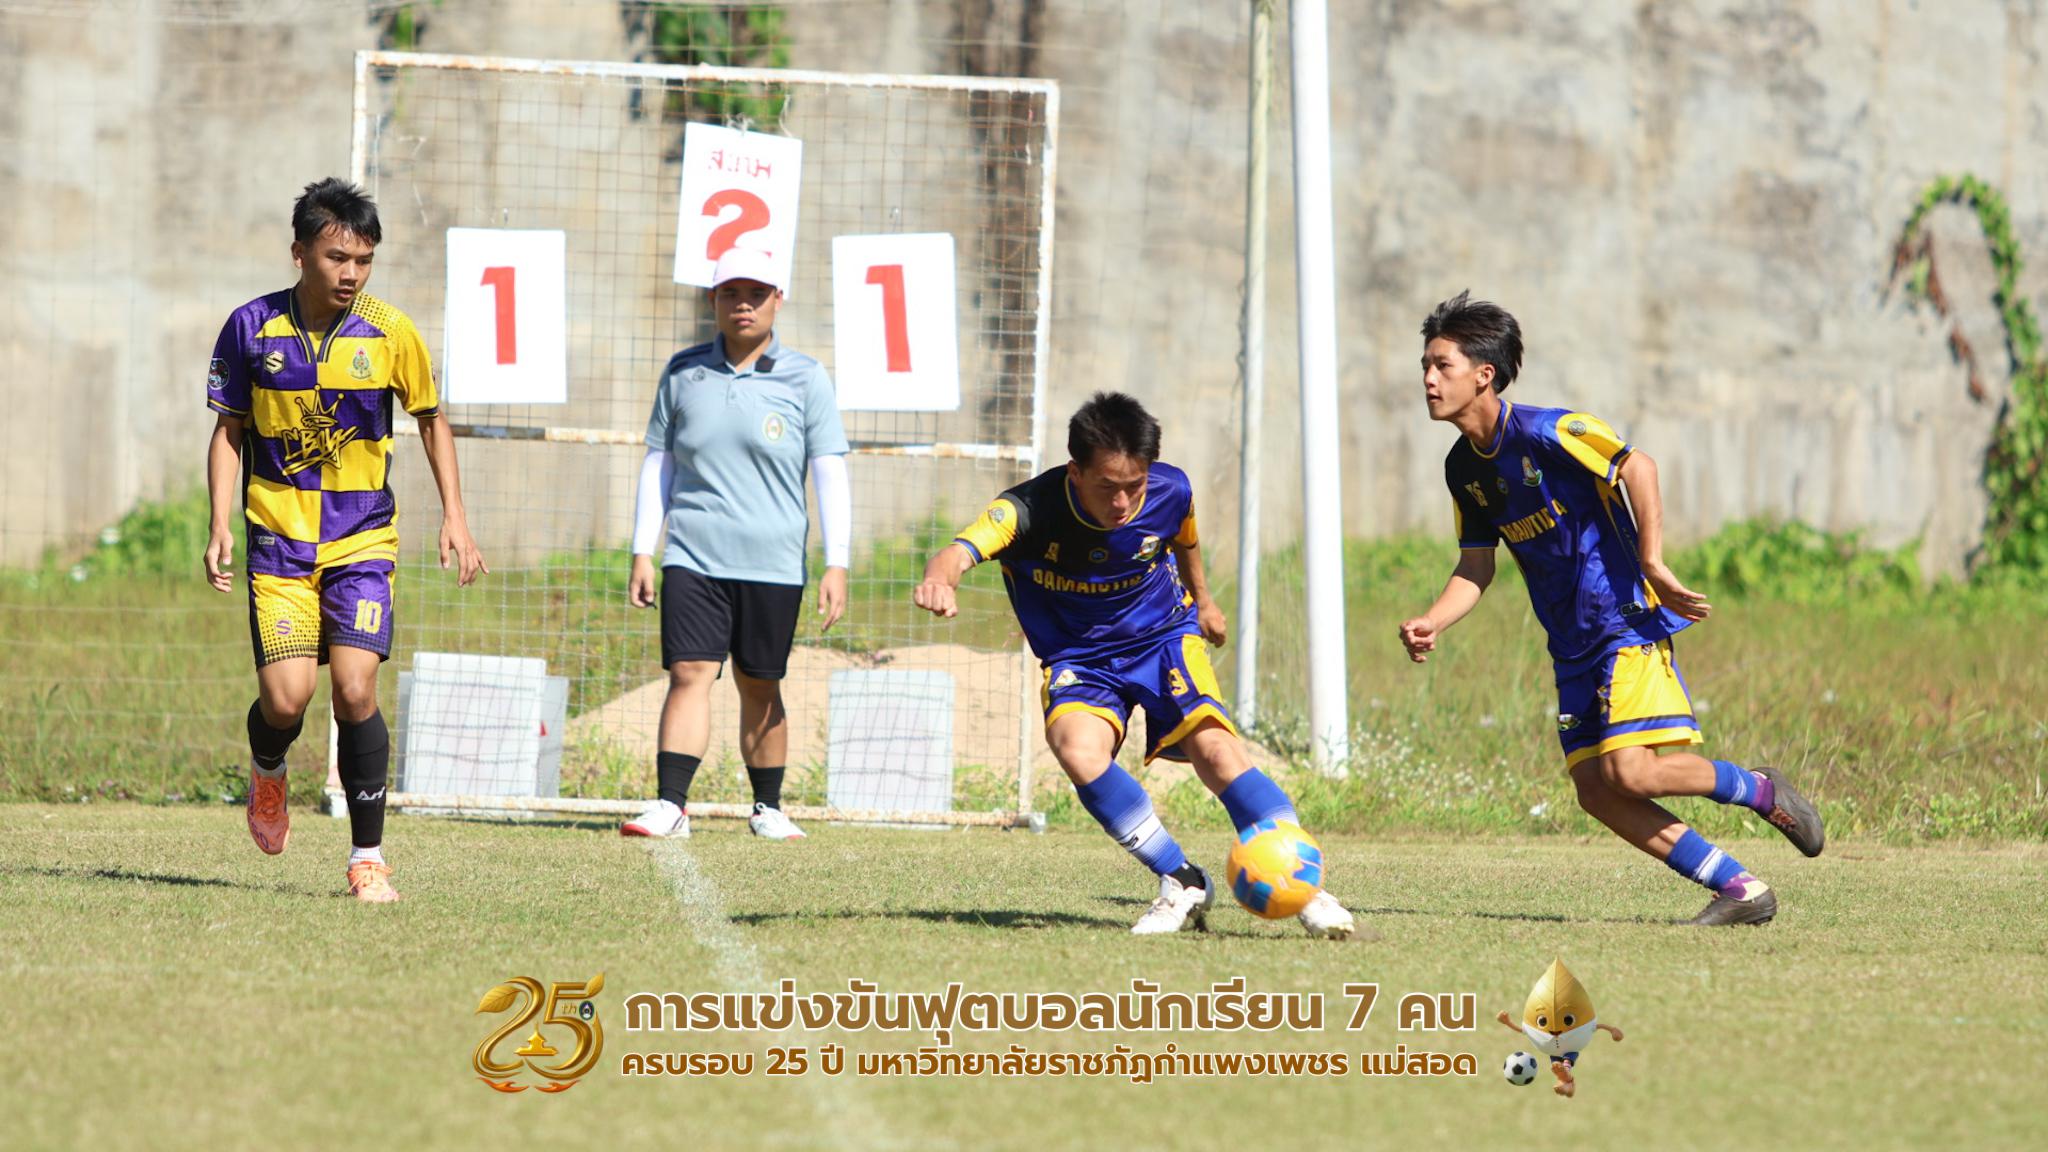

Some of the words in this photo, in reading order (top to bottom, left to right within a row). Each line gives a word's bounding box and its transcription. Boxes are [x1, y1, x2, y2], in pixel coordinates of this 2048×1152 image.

[701, 188, 772, 262] 2
[480, 265, 517, 366] 1
[865, 264, 912, 373] 1
[354, 598, 383, 635] 10
